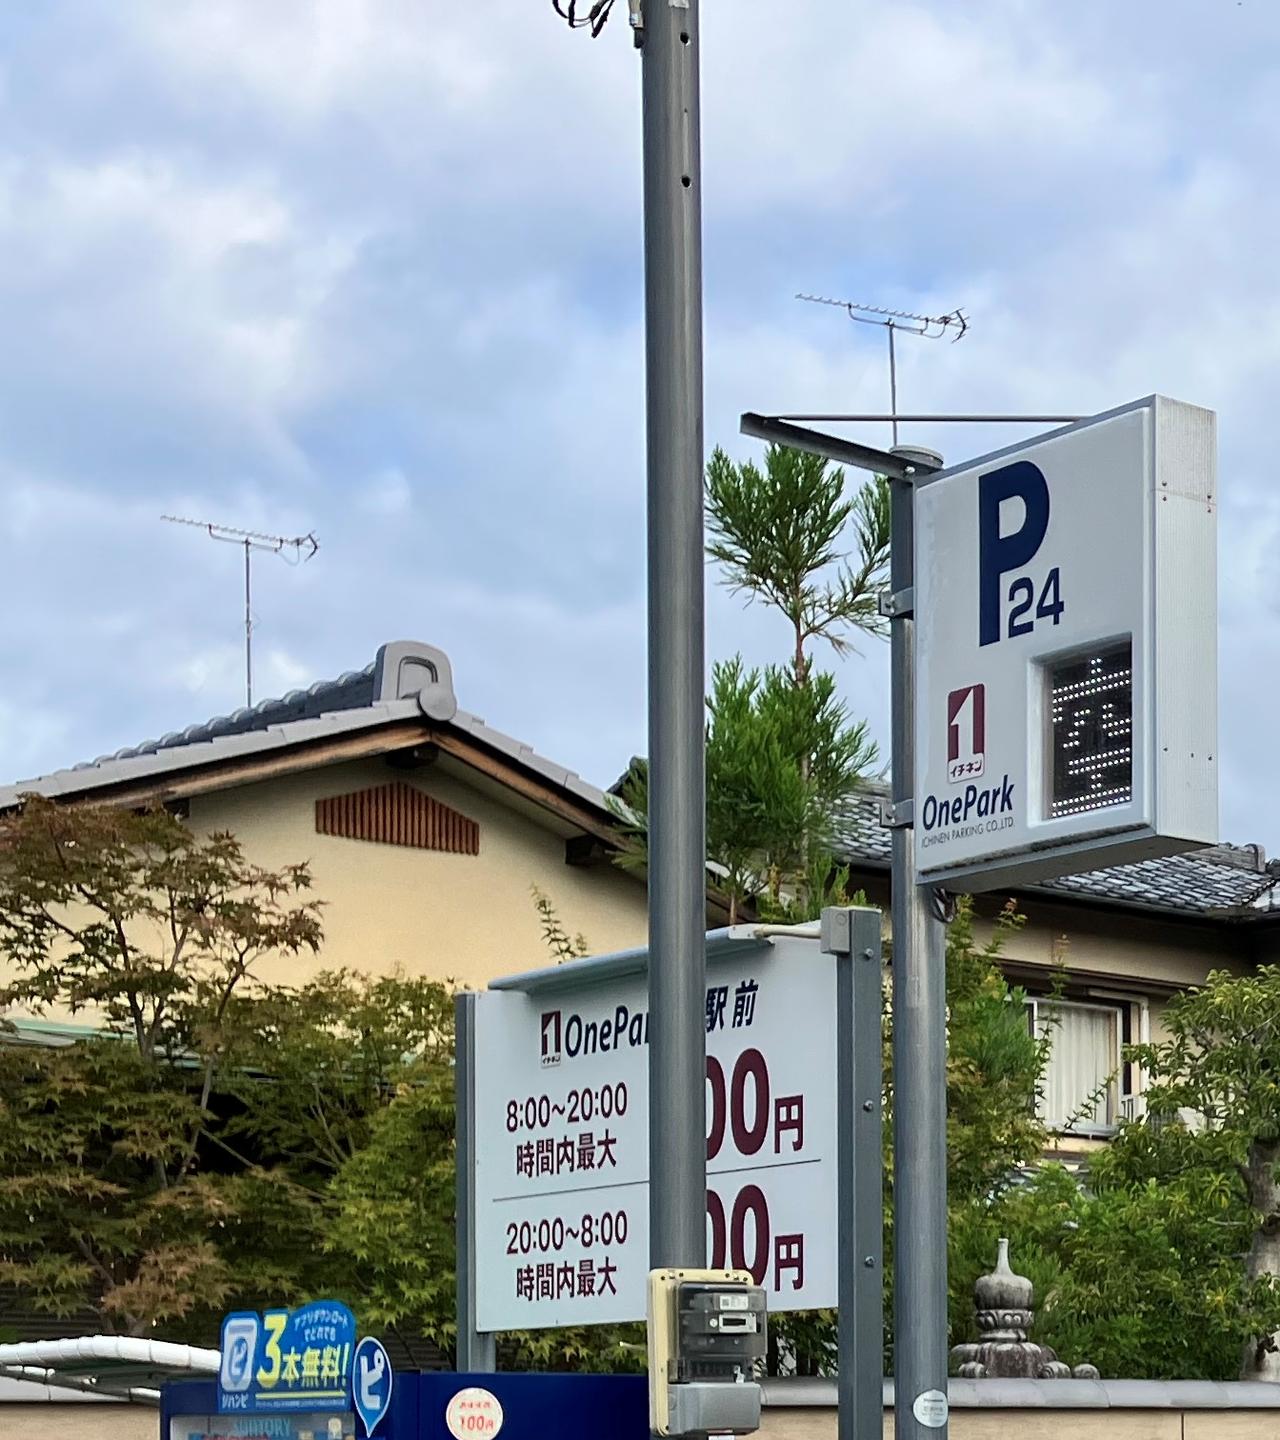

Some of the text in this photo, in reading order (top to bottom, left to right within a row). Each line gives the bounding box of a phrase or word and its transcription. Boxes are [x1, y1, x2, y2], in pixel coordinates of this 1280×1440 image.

[979, 461, 1064, 647] P 24
[950, 760, 982, 778] イチネン
[922, 774, 1015, 831] OnePark
[921, 830, 951, 849] ICHINEN
[951, 822, 984, 841] PARKING
[564, 1004, 649, 1058] OnePa
[516, 1128, 617, 1179] 時間内最大
[516, 1256, 617, 1302] 時間内最大
[360, 1349, 384, 1410] ピ
